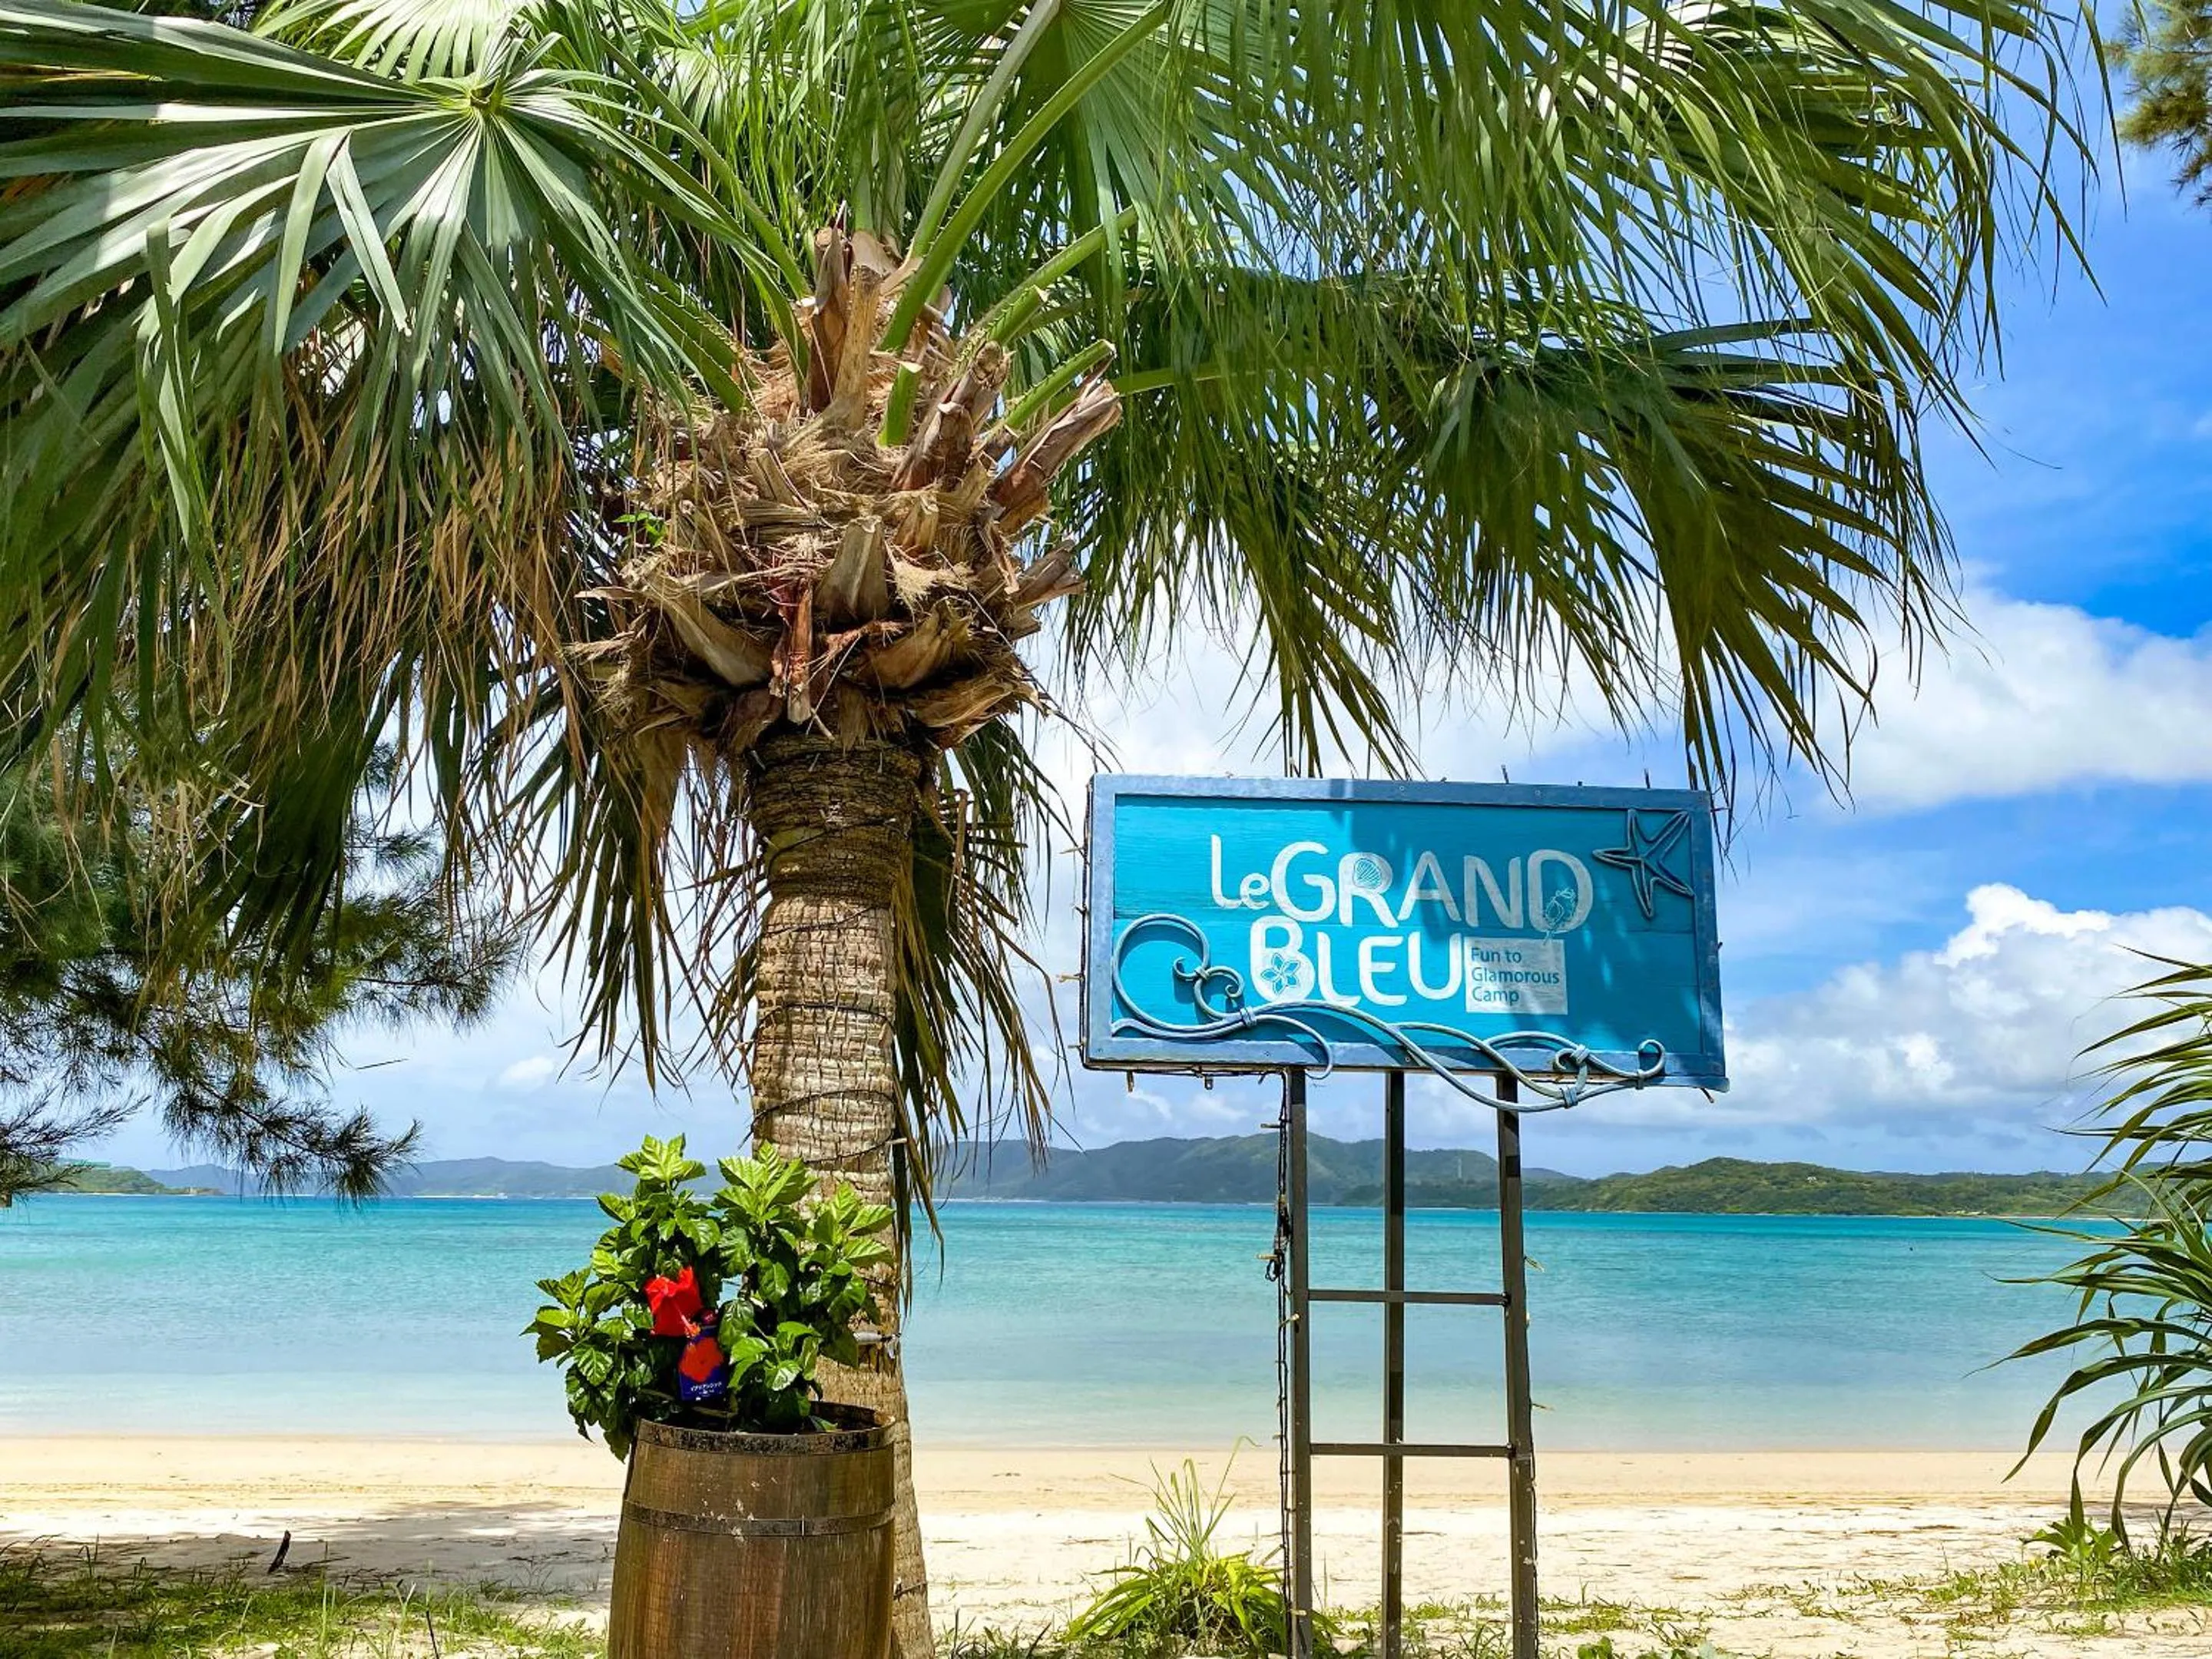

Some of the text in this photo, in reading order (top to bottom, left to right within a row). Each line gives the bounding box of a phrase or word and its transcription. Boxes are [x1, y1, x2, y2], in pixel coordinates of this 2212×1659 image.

[1210, 834, 1594, 932] Le GRAND
[1250, 916, 1462, 1006] BLEU
[1471, 948, 1522, 963] Fun to
[1471, 967, 1560, 984] Glamorous
[1472, 986, 1520, 1006] Camp
